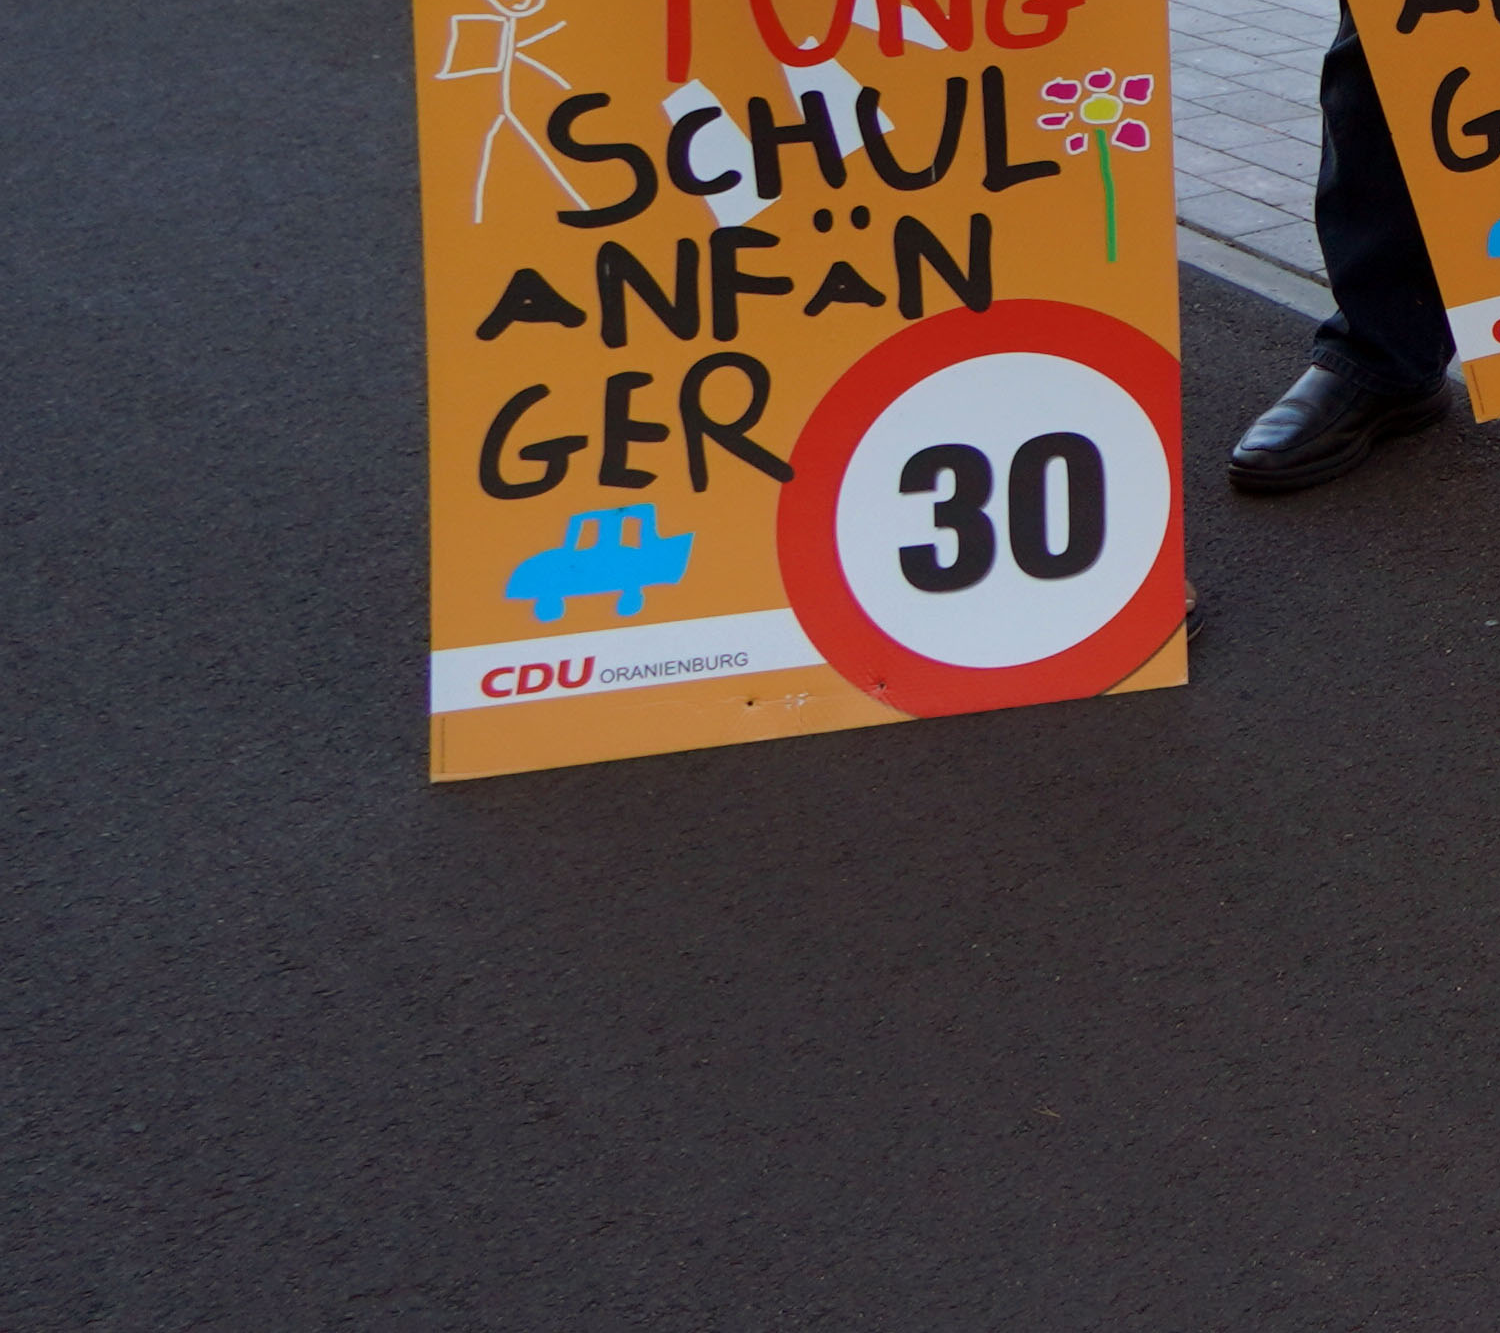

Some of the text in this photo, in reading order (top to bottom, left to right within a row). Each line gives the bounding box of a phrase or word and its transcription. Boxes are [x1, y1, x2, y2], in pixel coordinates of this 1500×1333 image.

[549, 66, 1060, 227] SCHUL
[477, 205, 993, 348] ANFÄN
[480, 352, 793, 499] GER
[897, 432, 1106, 594] 30
[481, 652, 749, 698] CDU ORANIENBURG
